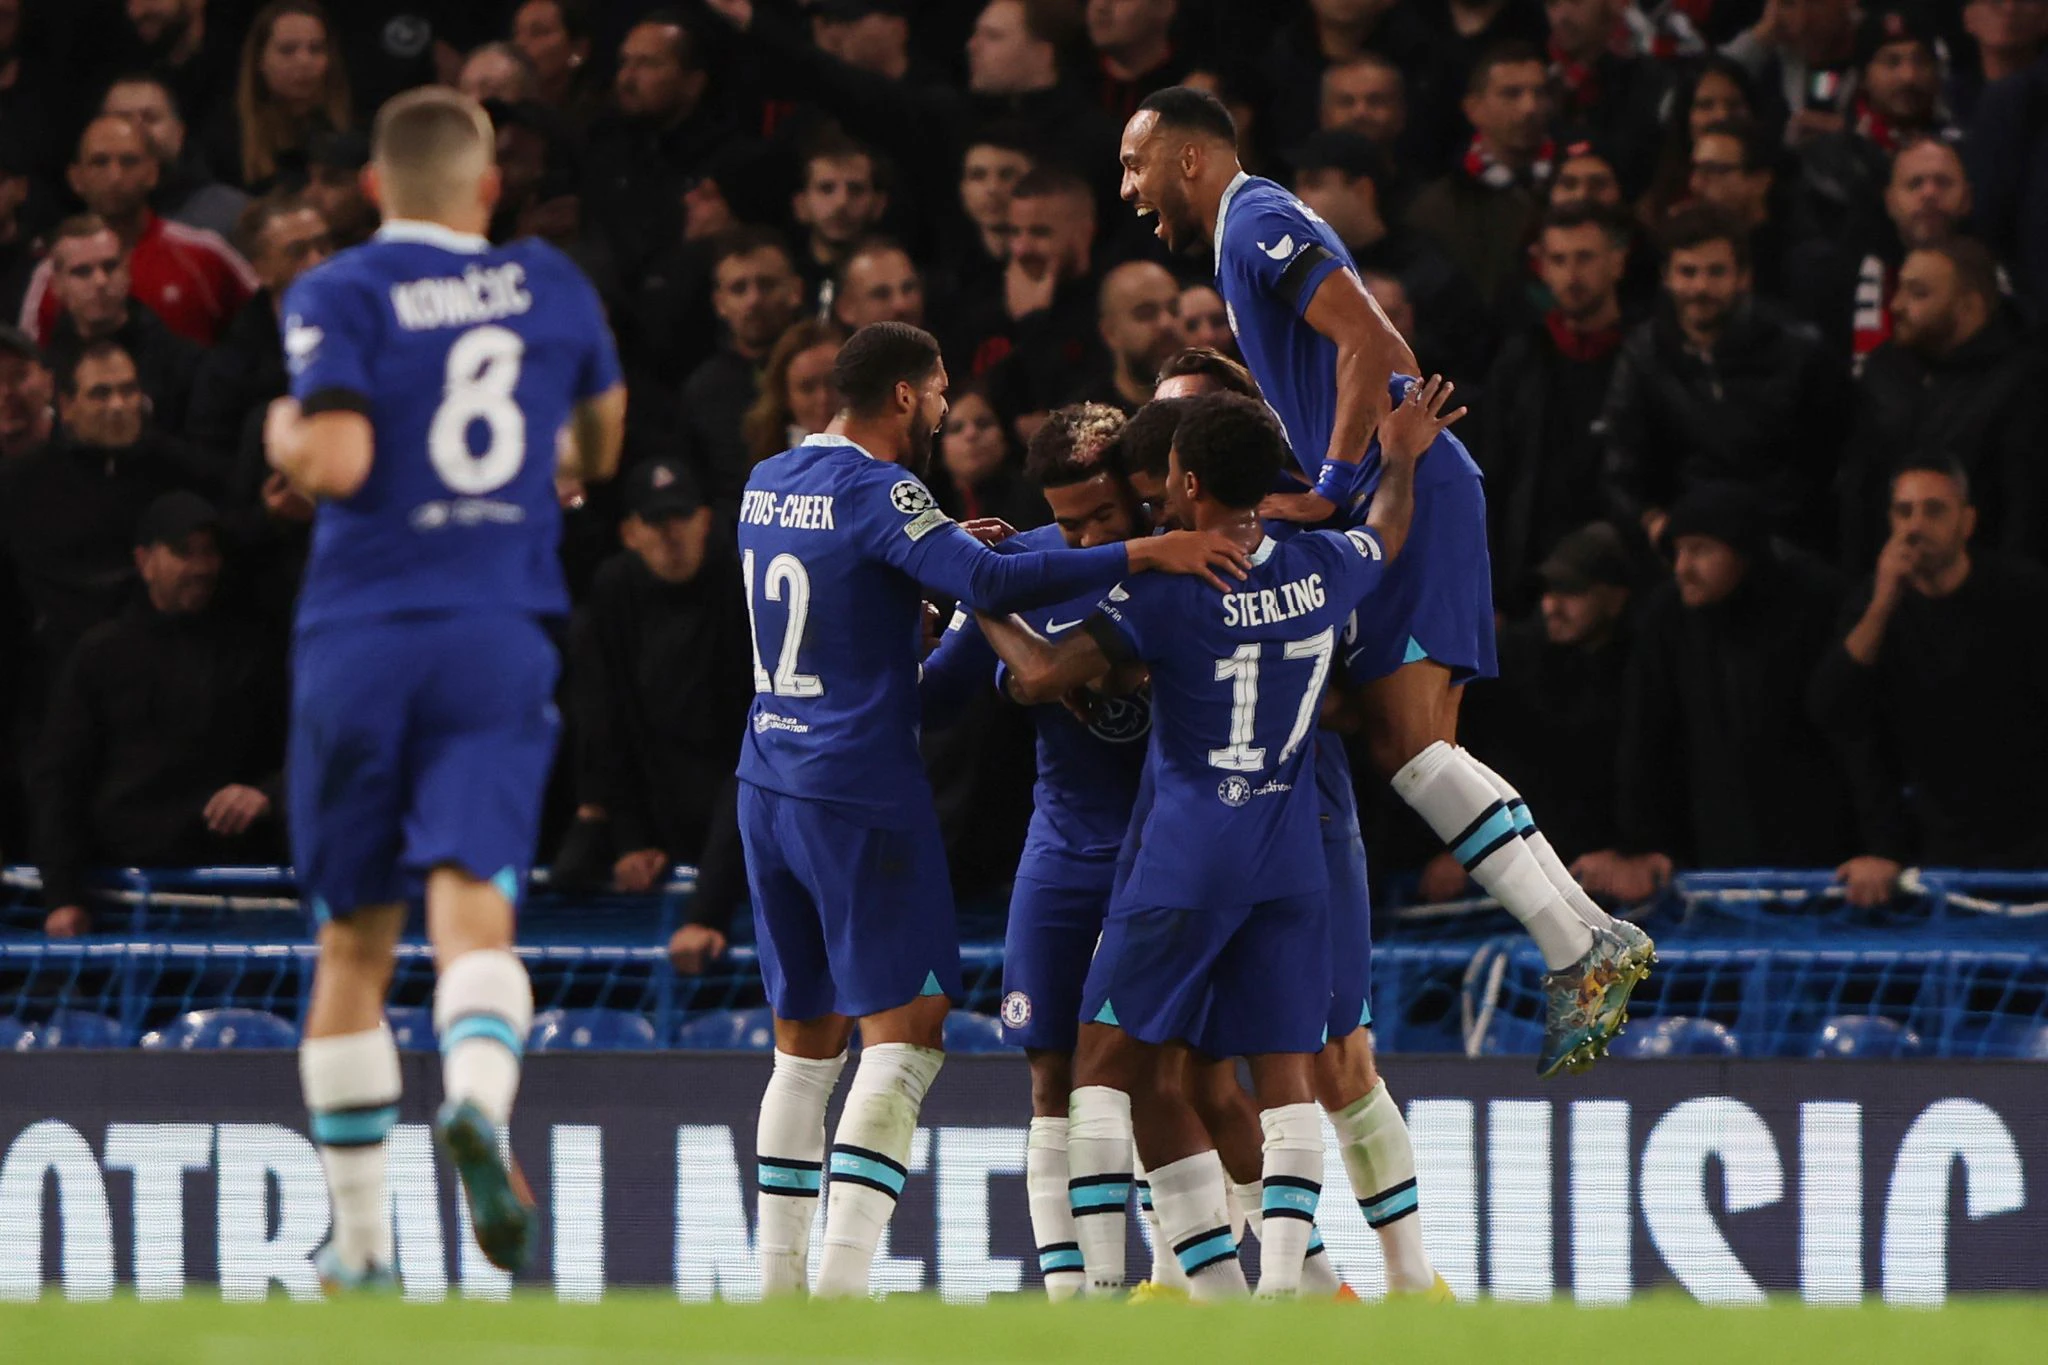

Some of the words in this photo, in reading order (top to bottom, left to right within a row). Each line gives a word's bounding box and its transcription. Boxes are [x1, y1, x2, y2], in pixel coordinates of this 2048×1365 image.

[426, 322, 527, 496] 8
[743, 548, 825, 697] 12
[1222, 573, 1326, 627] STERLING
[1208, 625, 1335, 772] 17
